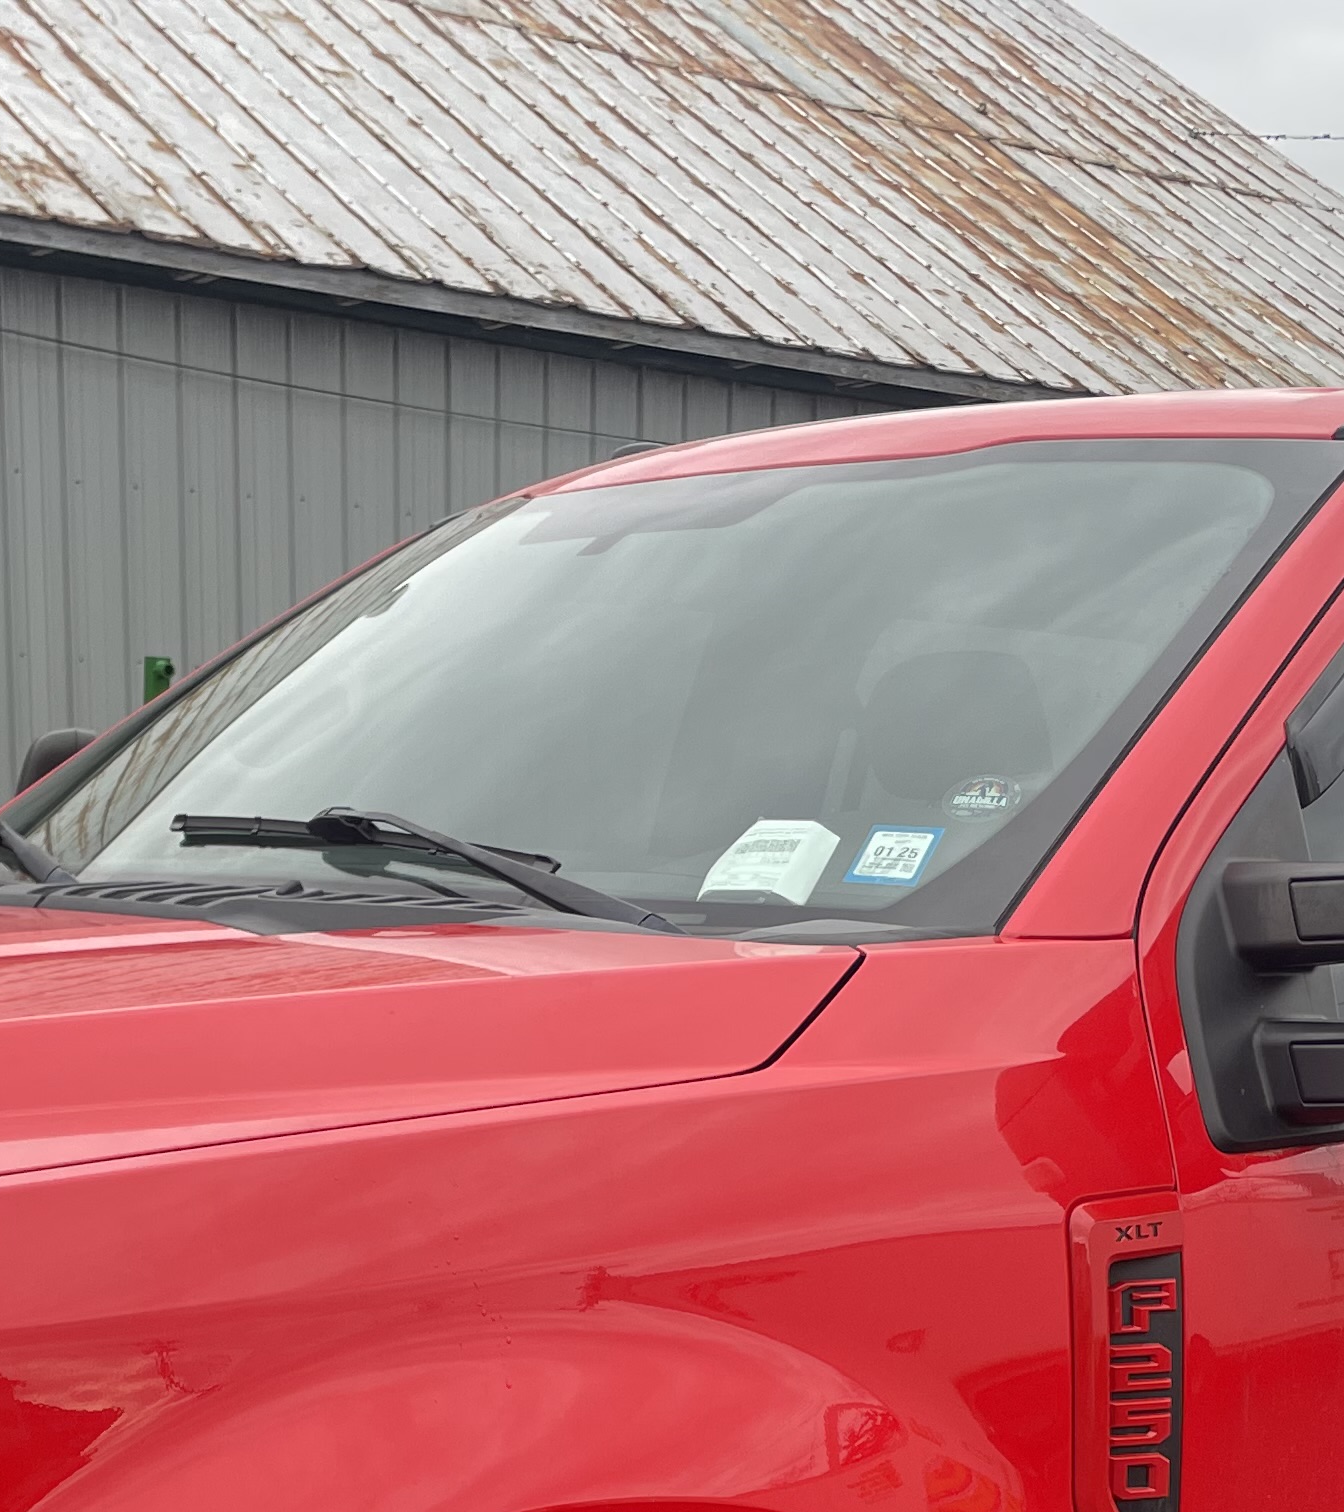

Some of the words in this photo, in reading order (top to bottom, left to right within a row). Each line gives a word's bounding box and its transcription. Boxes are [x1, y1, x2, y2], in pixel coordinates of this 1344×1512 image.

[874, 845, 894, 857] 01
[897, 847, 920, 859] 25
[1115, 1221, 1163, 1242] XLT
[1108, 1278, 1177, 1500] F250
